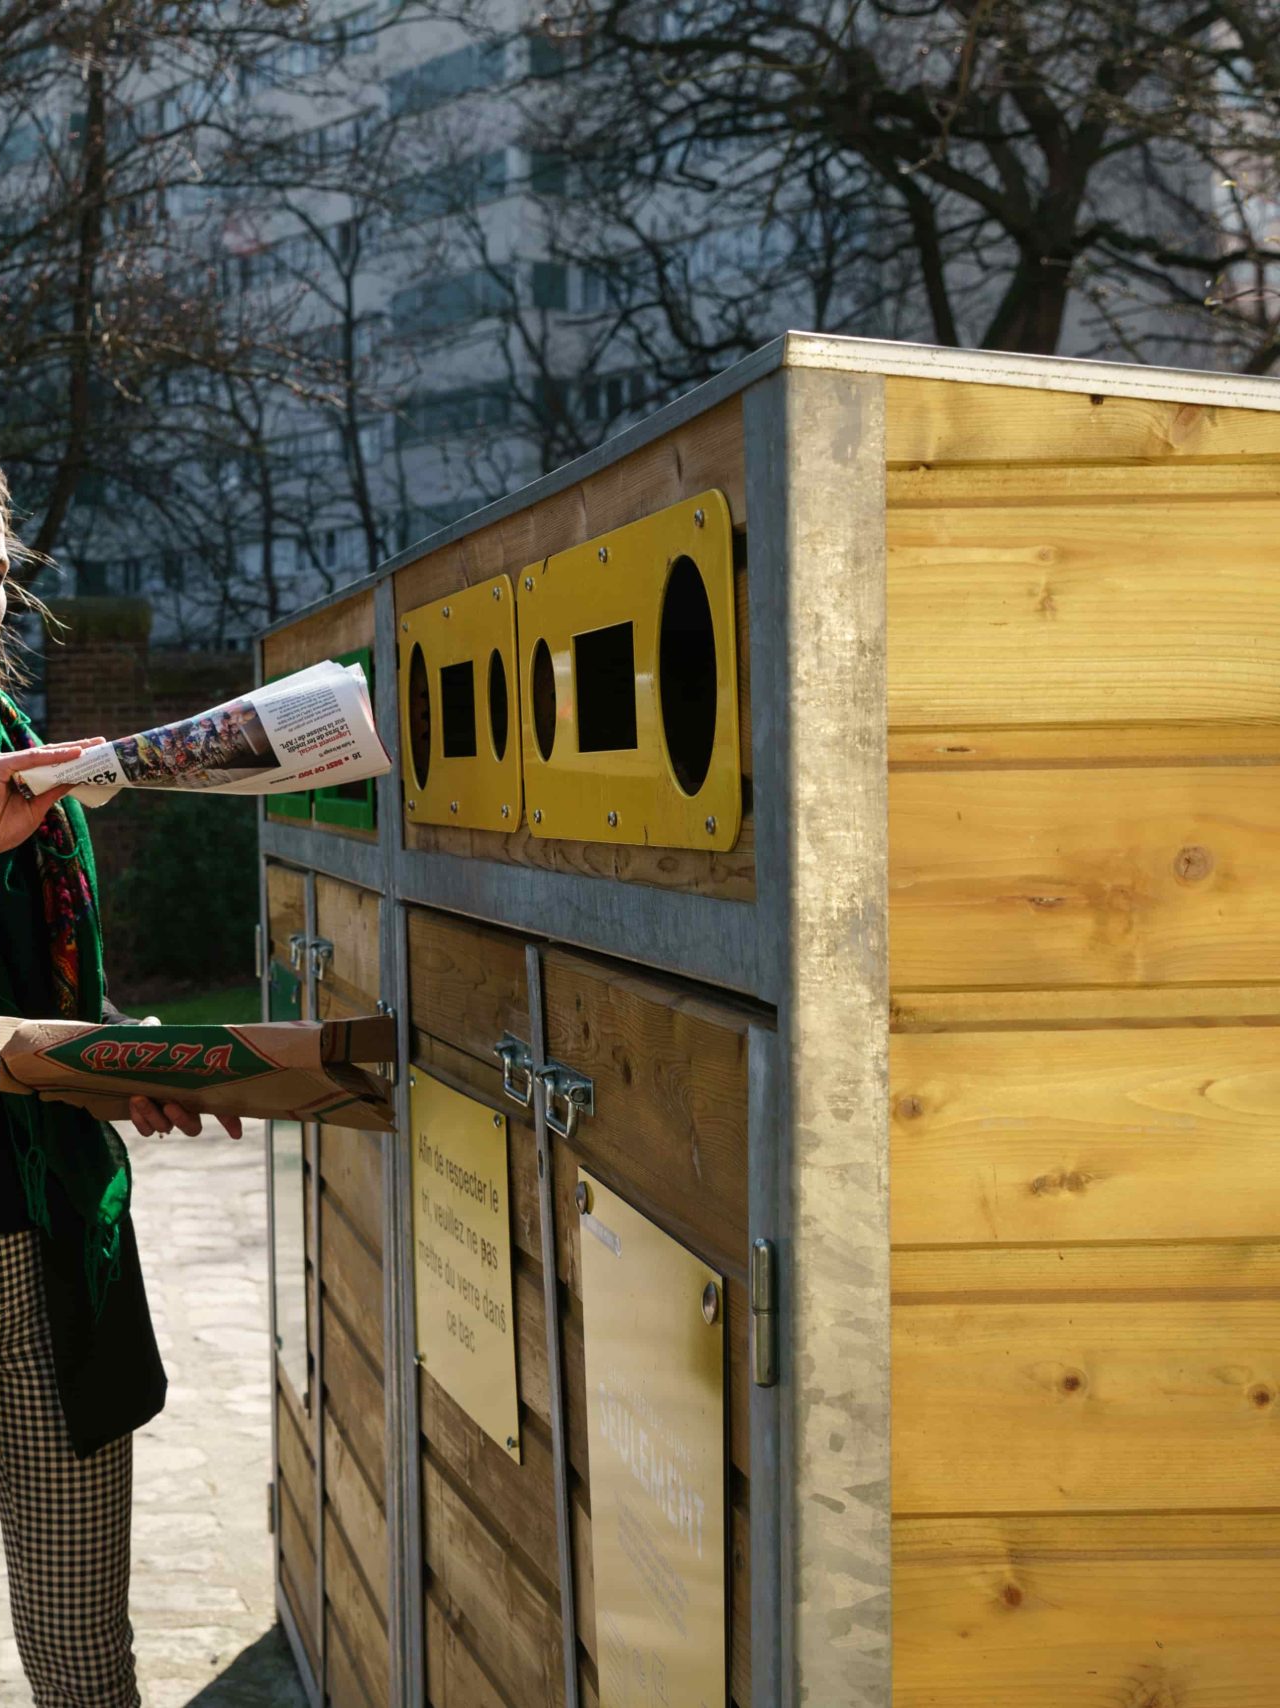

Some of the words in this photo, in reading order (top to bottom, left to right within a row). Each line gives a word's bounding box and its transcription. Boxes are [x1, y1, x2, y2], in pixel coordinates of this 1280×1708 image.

[326, 721, 334, 730] la
[333, 716, 345, 726] sur
[339, 722, 348, 732] Le
[297, 733, 306, 742] de
[305, 724, 327, 738] baisse
[315, 733, 325, 742] de
[324, 726, 340, 738] bras
[317, 729, 351, 747] Logement
[352, 751, 362, 760] 16
[314, 764, 325, 774] OF
[325, 759, 343, 770] BEST
[78, 770, 117, 785] 43,
[80, 1040, 241, 1076] PIZZA
[419, 1132, 432, 1168] Afin
[434, 1144, 444, 1176] de
[446, 1158, 487, 1205] respecter
[489, 1179, 499, 1214] le
[422, 1187, 433, 1222] tri,
[434, 1202, 464, 1244] veuillez
[466, 1227, 478, 1255] ne
[481, 1237, 498, 1271] pas
[418, 1239, 443, 1278] mettre
[444, 1257, 456, 1289] du
[458, 1273, 480, 1311] verre
[482, 1288, 506, 1333] dans
[447, 1309, 457, 1336] ce
[459, 1313, 476, 1353] bac
[598, 1383, 705, 1560] SEULEMENT
